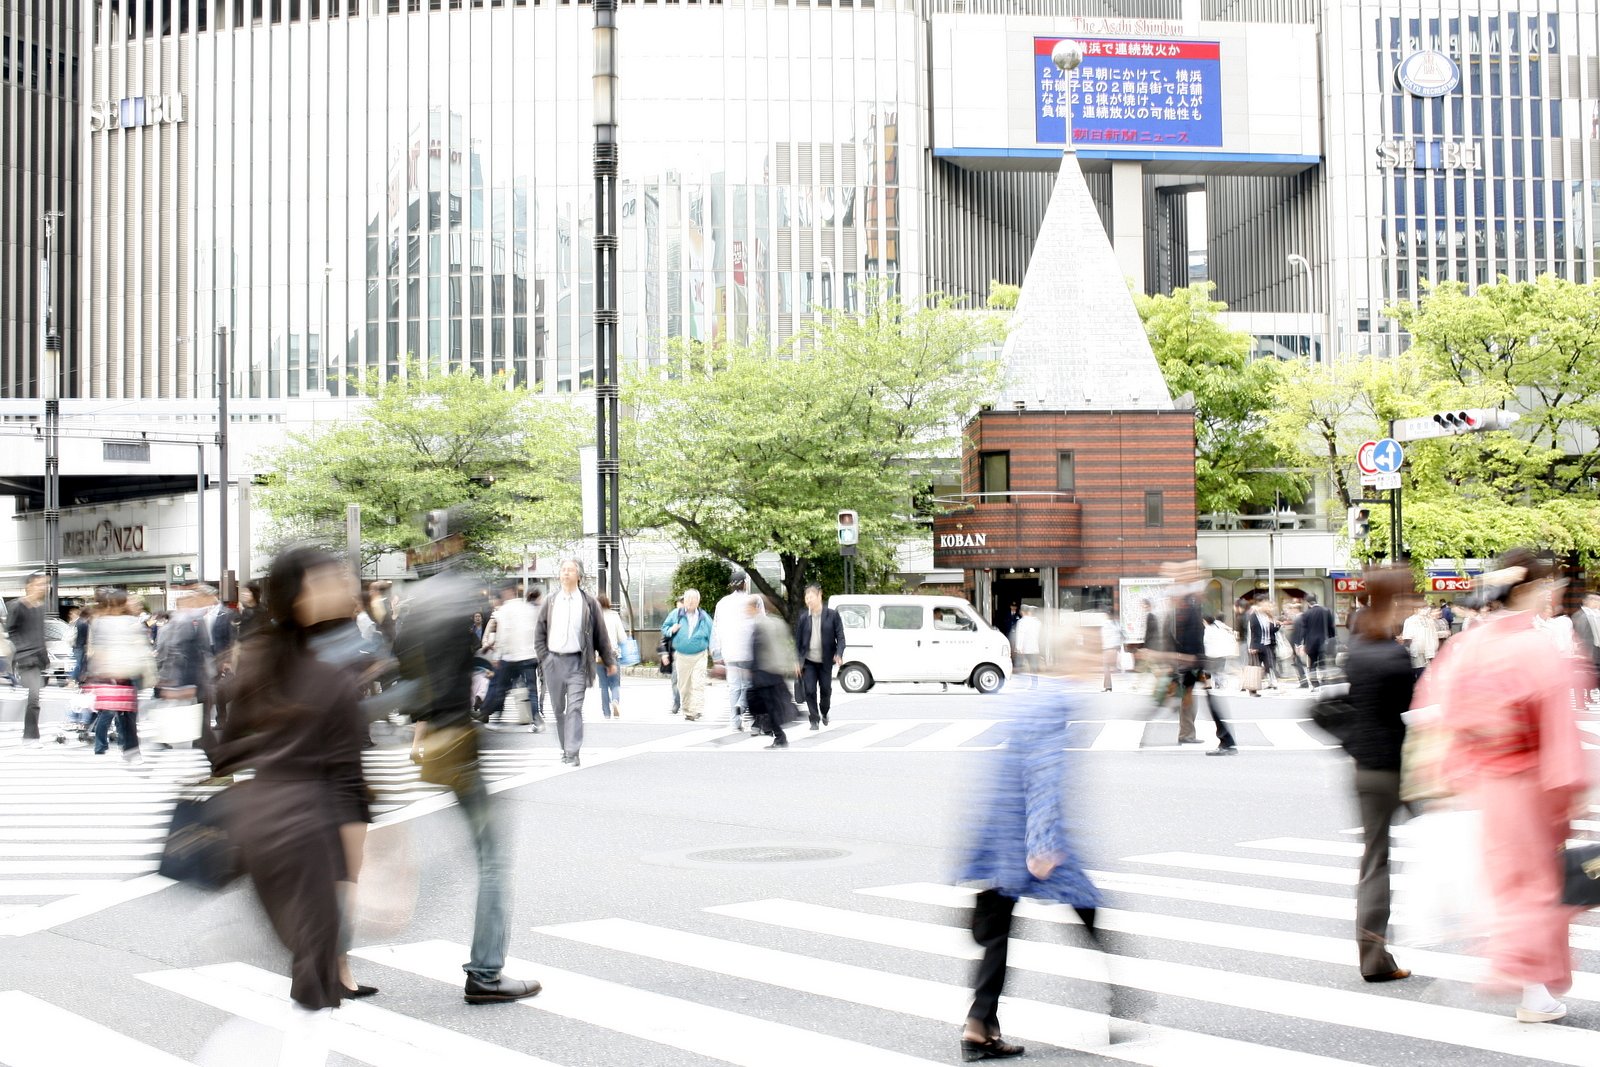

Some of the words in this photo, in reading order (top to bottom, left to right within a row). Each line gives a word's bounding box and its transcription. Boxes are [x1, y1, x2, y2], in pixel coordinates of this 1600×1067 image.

[1072, 17, 1095, 33] The
[1098, 18, 1132, 35] Asahi
[1403, 75, 1421, 93] TOKYU
[1423, 77, 1457, 95] RECREATION
[90, 92, 184, 131] SEIBU
[1376, 140, 1482, 170] SEIBU
[940, 533, 987, 548] KOBAN
